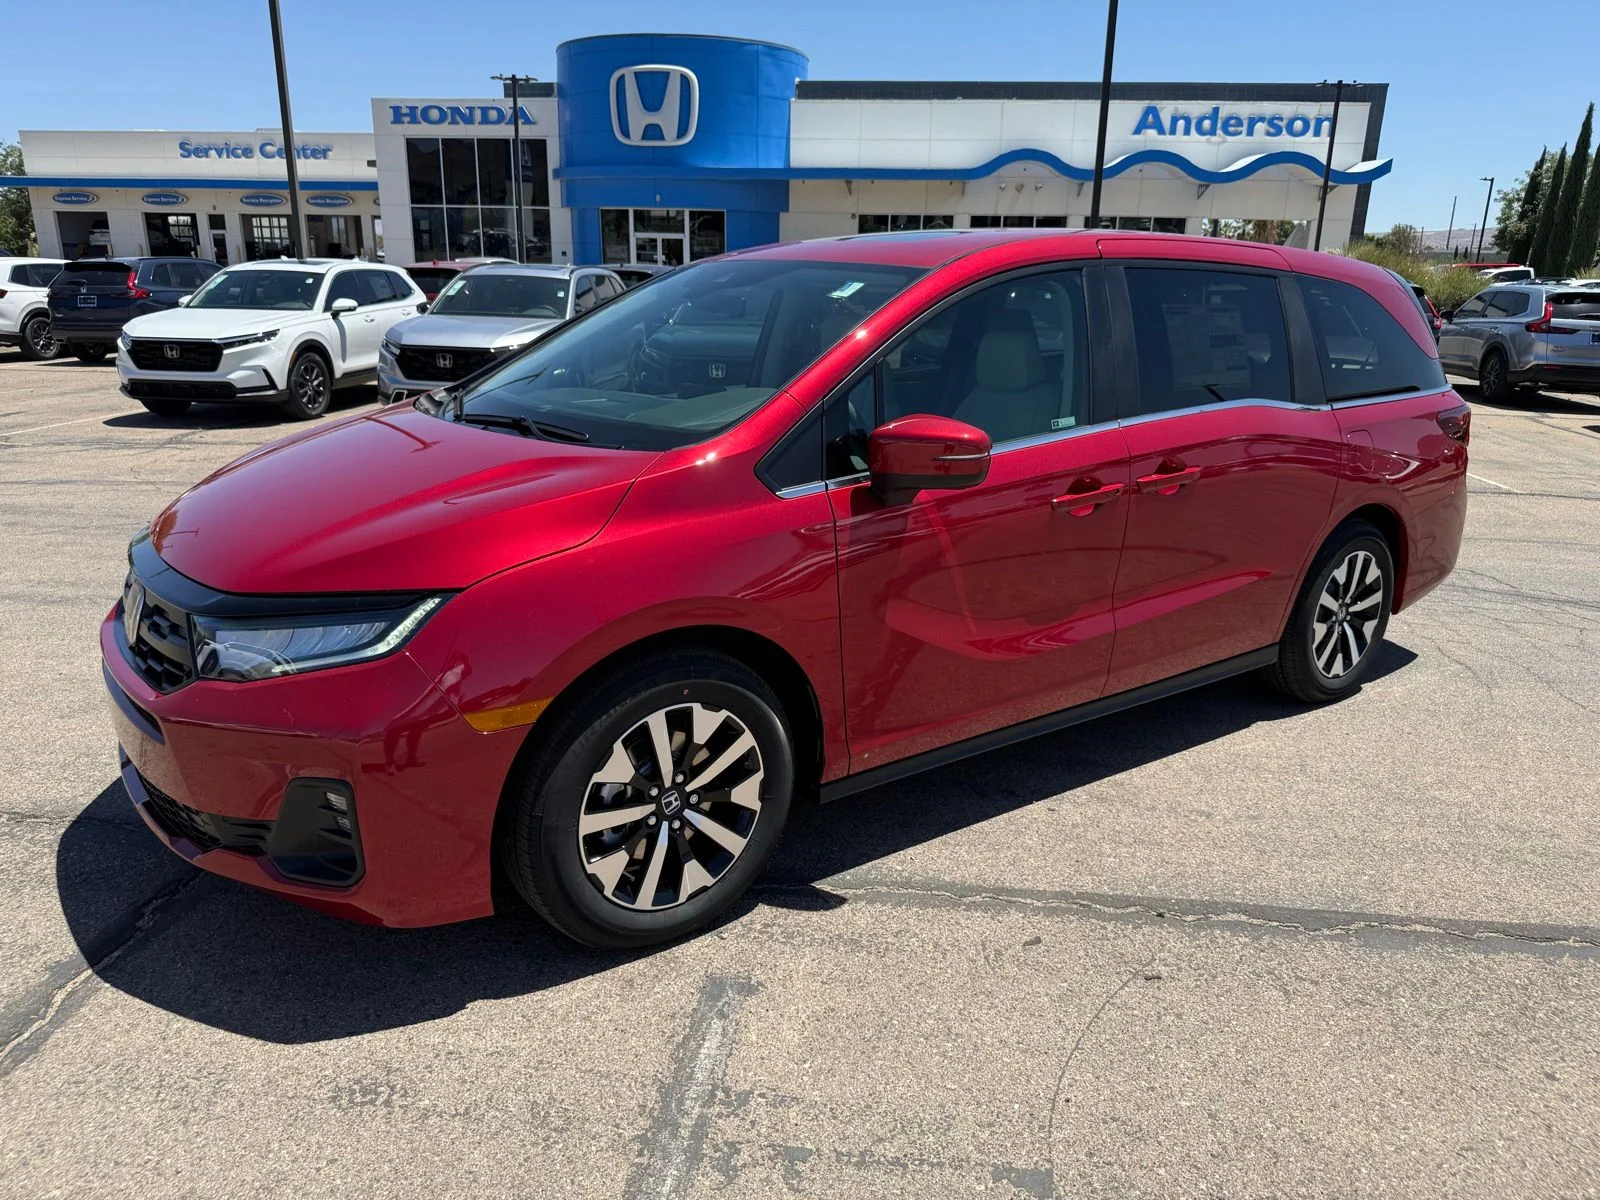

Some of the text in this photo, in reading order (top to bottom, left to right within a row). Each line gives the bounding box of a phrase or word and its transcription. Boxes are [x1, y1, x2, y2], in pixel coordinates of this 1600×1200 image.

[389, 104, 537, 125] HONDA
[1132, 104, 1334, 138] Anderson
[178, 140, 254, 159] Service
